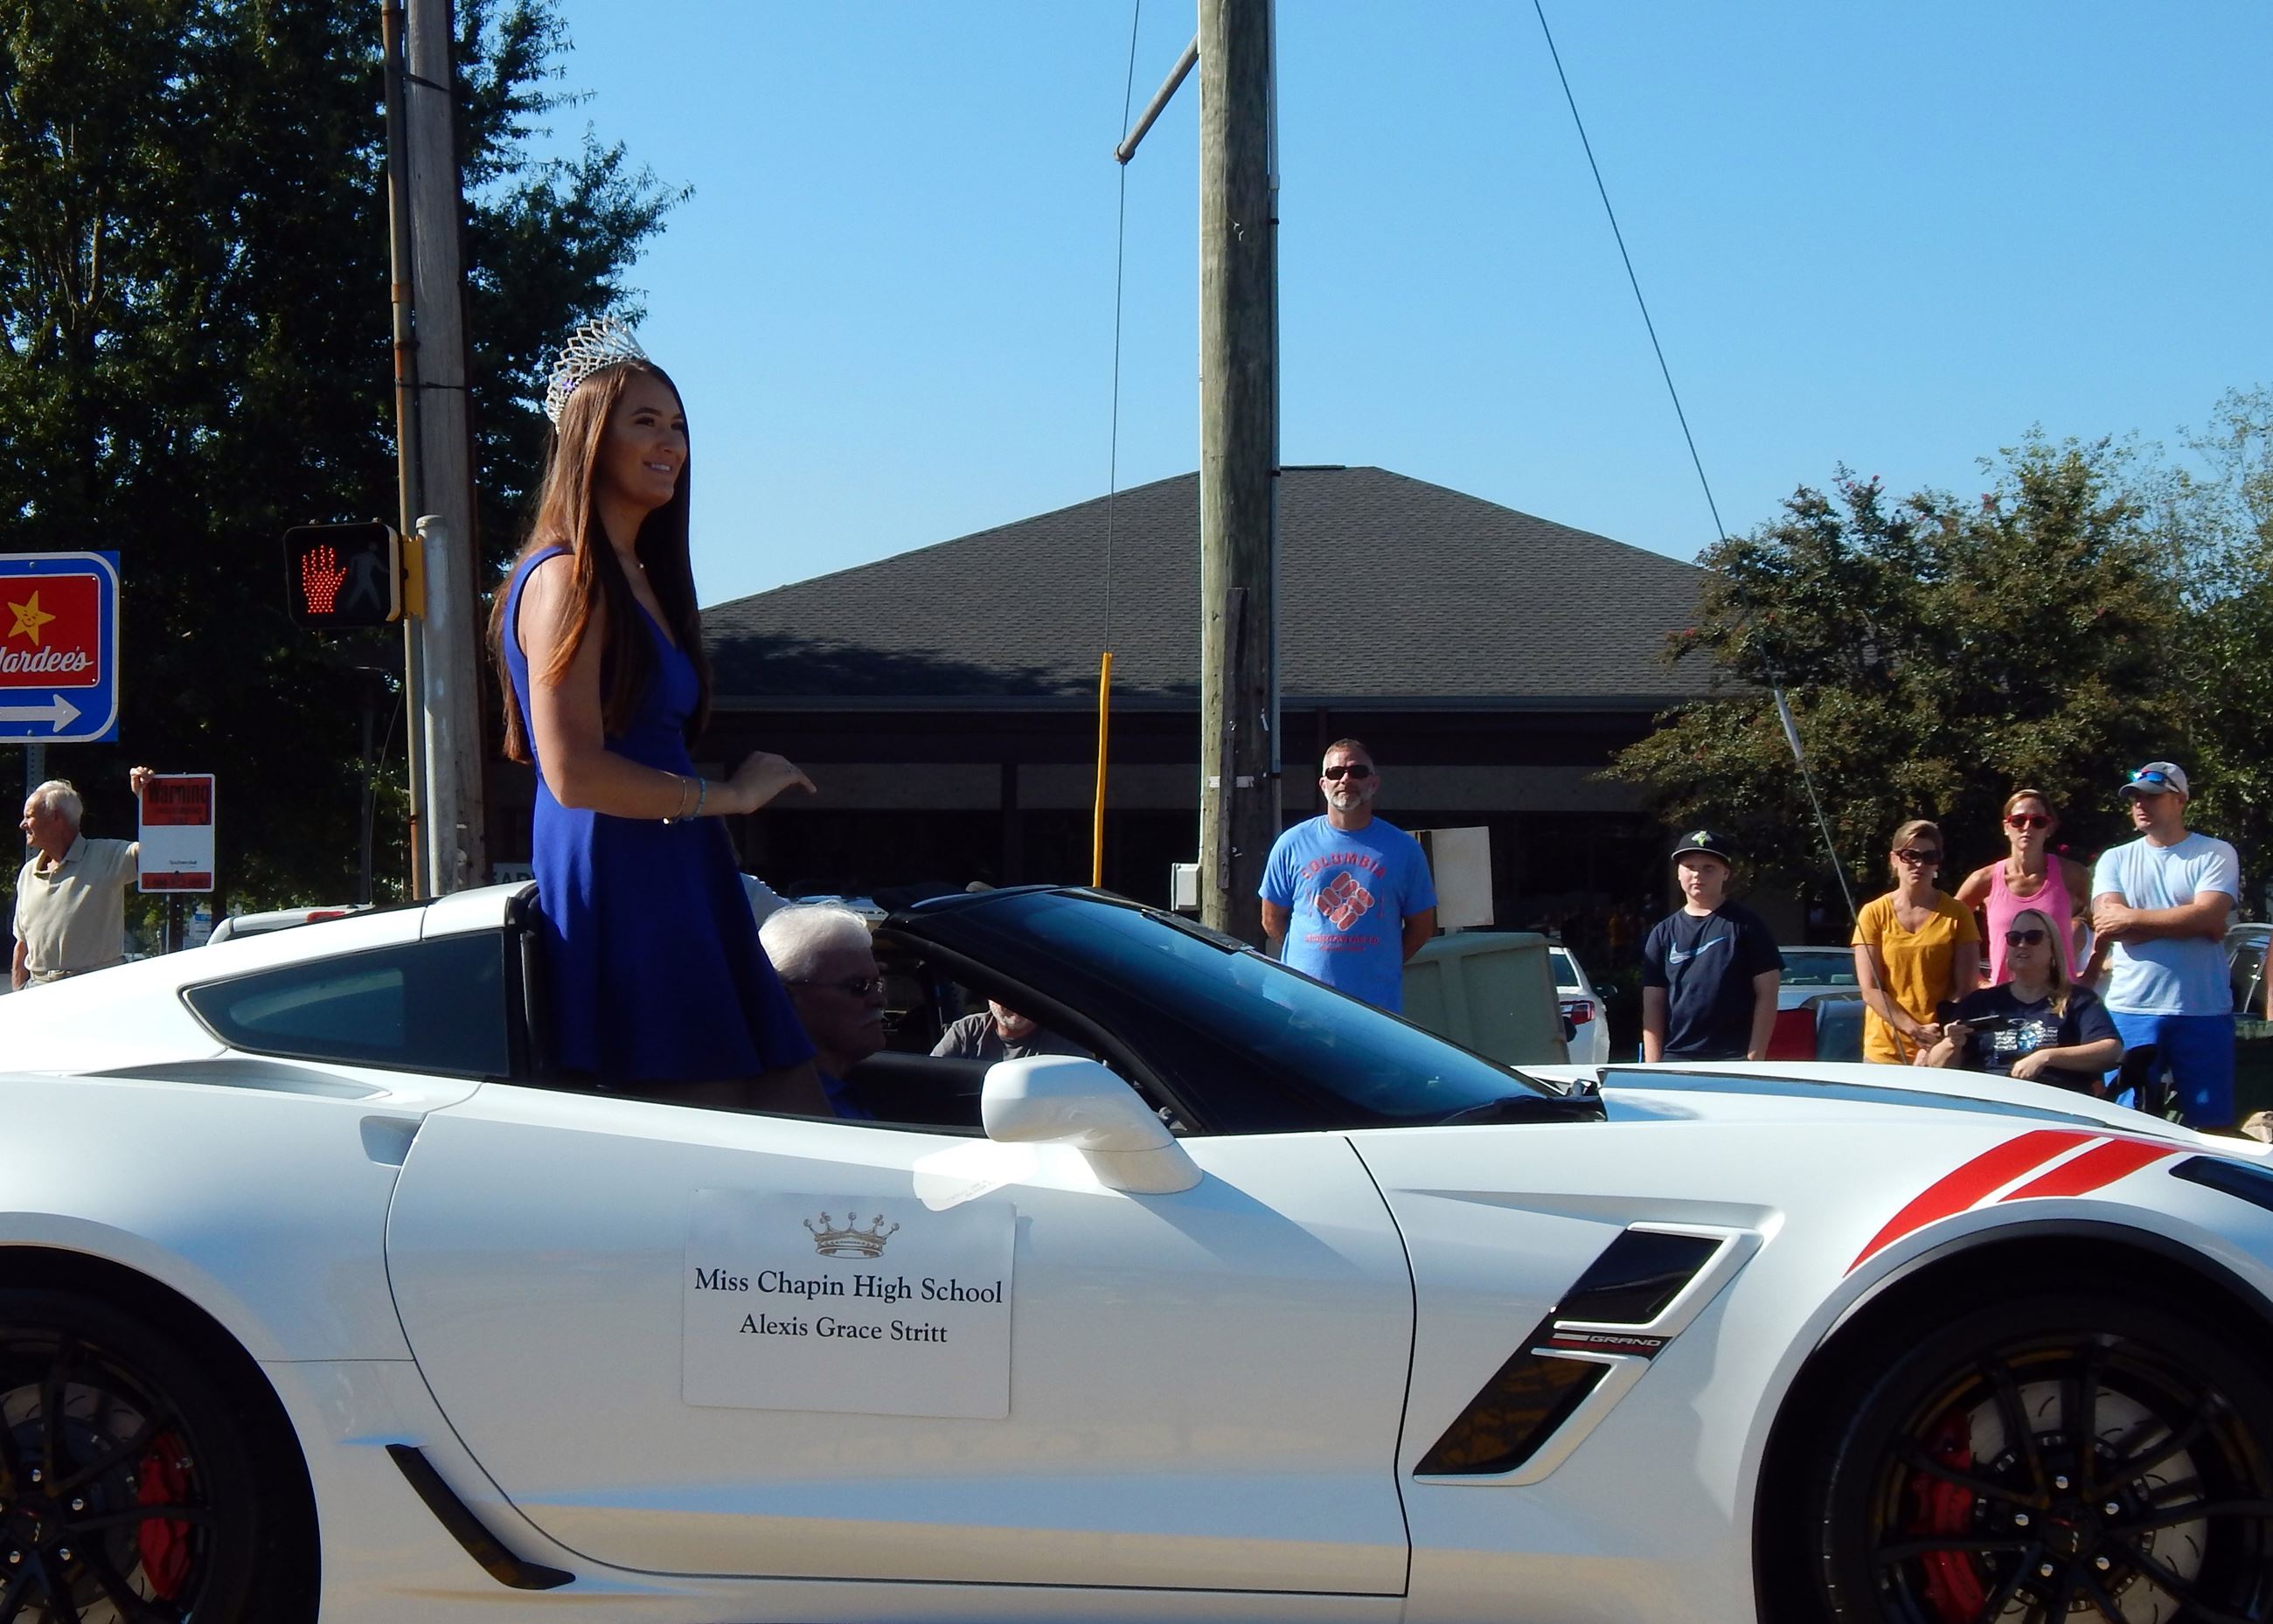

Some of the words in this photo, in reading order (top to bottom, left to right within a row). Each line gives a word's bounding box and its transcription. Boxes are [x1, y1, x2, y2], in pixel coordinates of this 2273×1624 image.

[1300, 852, 1387, 879] COLUMBIA
[694, 1267, 749, 1292] Miss
[757, 1270, 845, 1300] Chapin
[853, 1274, 913, 1303] High
[921, 1278, 1003, 1303] School
[739, 1313, 808, 1336] Alexis
[816, 1316, 883, 1339] Grace
[890, 1320, 949, 1343] Stritt
[1589, 1335, 1662, 1347] GRAND
